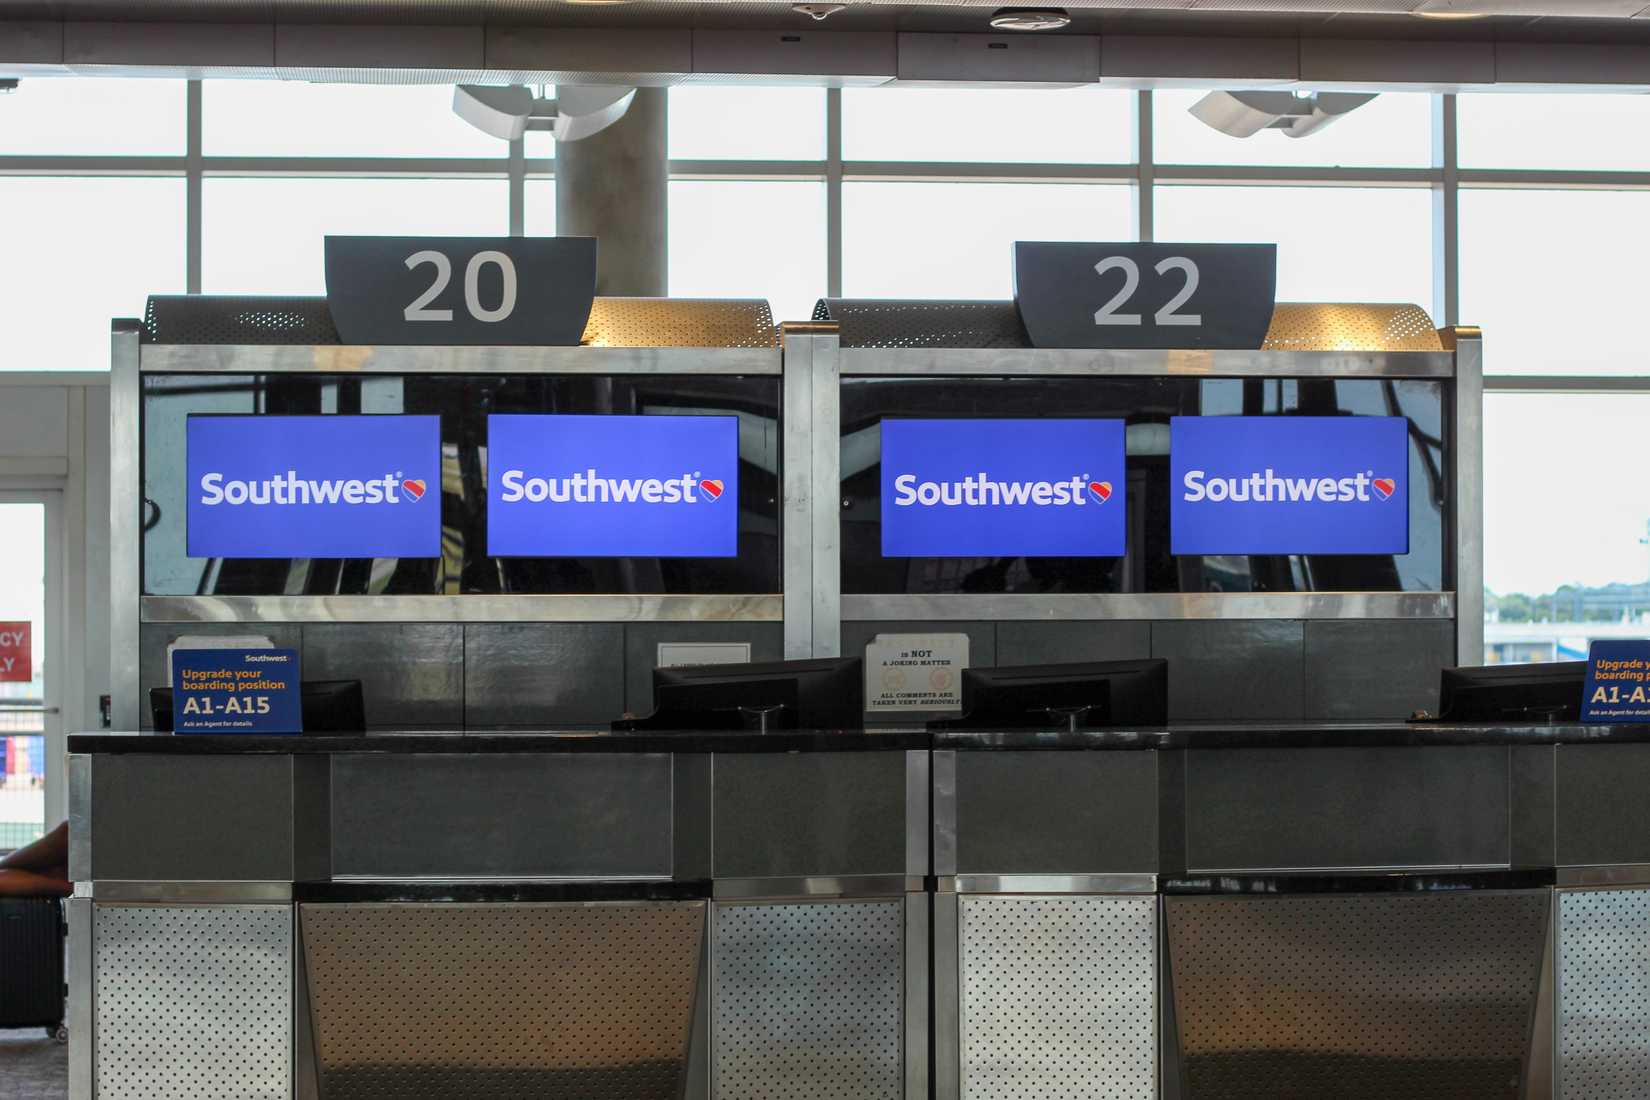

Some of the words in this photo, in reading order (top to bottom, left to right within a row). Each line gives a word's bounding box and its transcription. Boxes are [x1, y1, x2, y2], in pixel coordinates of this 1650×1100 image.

[403, 249, 518, 323] 20
[1093, 255, 1202, 326] 22
[201, 470, 400, 505] Southwest
[501, 469, 697, 503] Southwest
[894, 472, 1087, 506] Southwest
[1183, 469, 1370, 502] Southwest
[245, 654, 288, 663] Southwest
[911, 650, 933, 658] NOT
[1597, 659, 1642, 671] Upgrade
[182, 669, 232, 681] Upgrade
[235, 671, 262, 681] your
[1595, 670, 1644, 682] boarding
[182, 680, 235, 692] boarding
[238, 680, 286, 692] position
[183, 696, 271, 715] A1-A15
